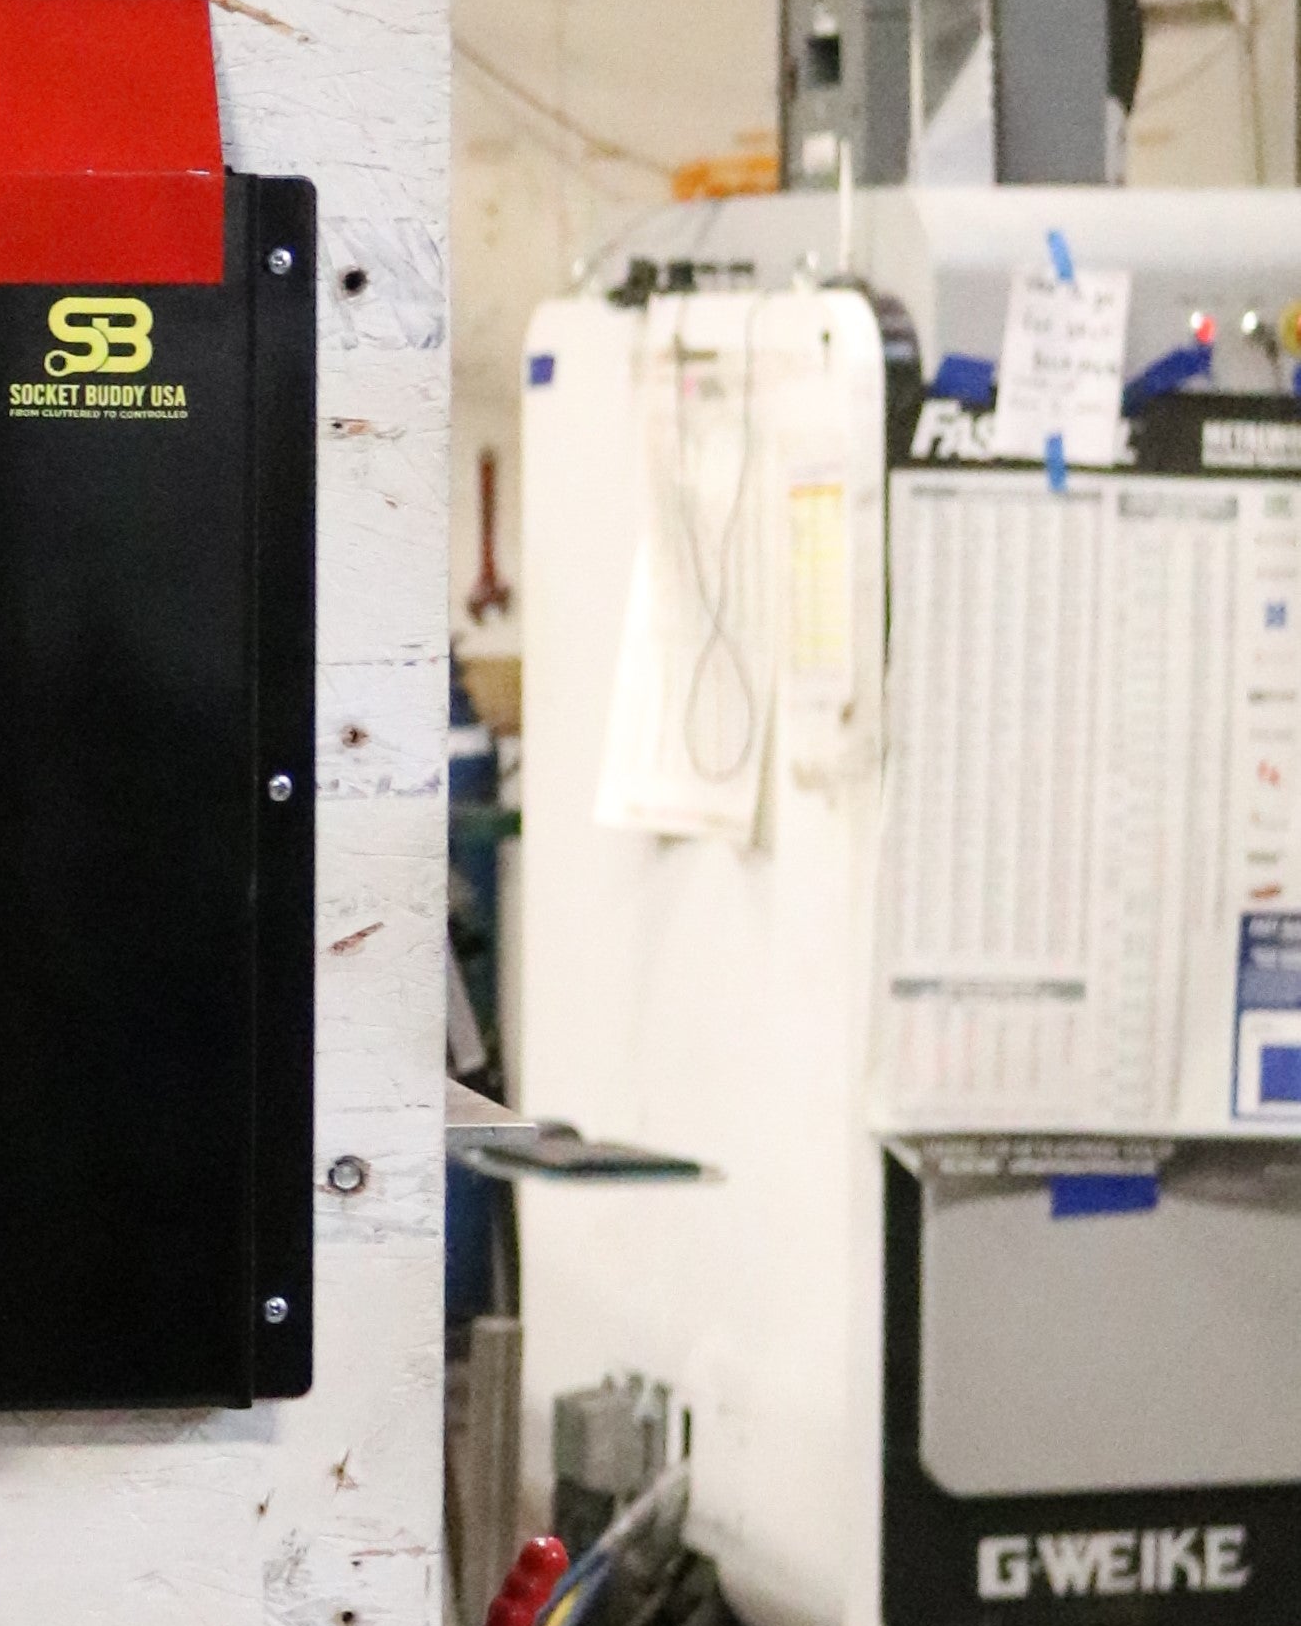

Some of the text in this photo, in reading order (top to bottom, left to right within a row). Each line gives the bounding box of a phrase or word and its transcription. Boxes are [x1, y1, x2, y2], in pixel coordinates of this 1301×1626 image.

[9, 383, 187, 407] SOCKET BUDDY USA
[8, 408, 189, 420] FROM CLUTTERED TO CONTROLLED
